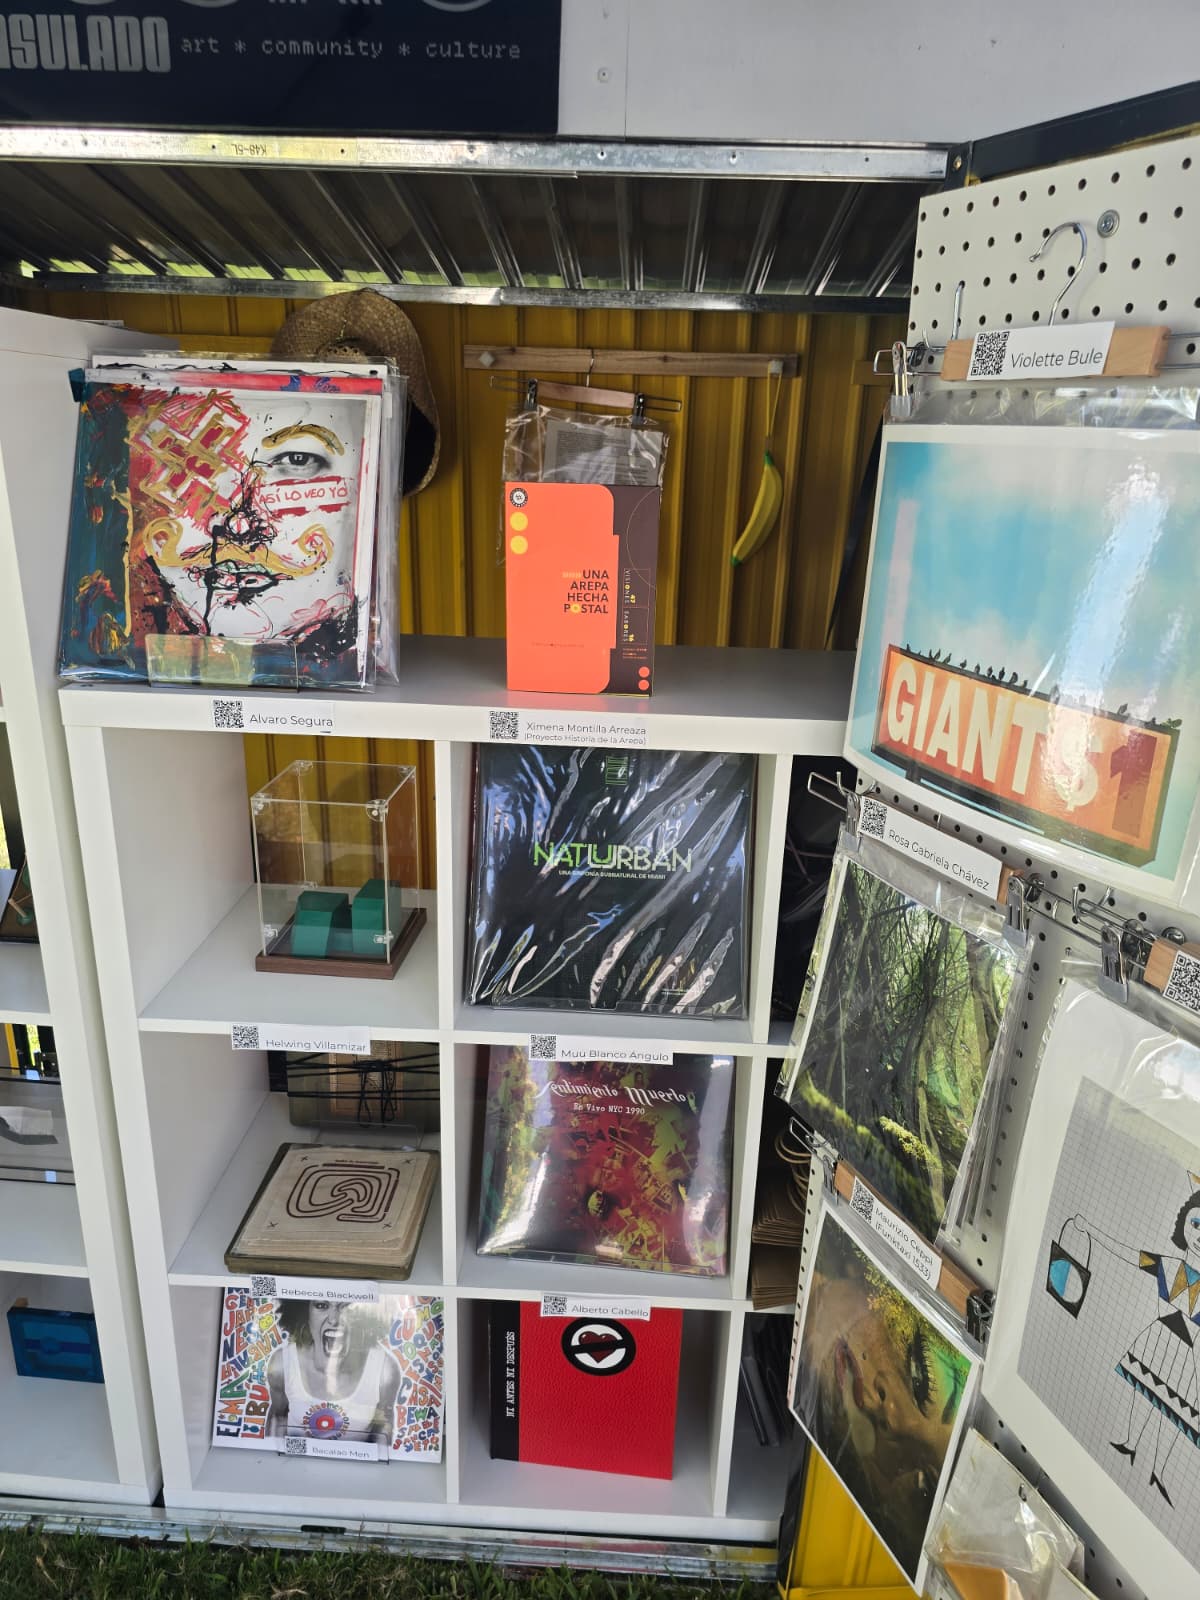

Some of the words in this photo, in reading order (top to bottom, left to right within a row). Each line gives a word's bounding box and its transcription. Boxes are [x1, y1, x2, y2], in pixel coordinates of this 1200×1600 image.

[182, 38, 219, 53] art
[261, 39, 383, 58] community
[426, 42, 521, 59] culture
[1012, 352, 1064, 368] Violette
[1068, 348, 1103, 366] Bule
[285, 491, 302, 501] LO
[305, 488, 325, 498] VEO
[330, 487, 348, 498] YO
[583, 569, 609, 579] UNA
[570, 582, 609, 591] AREPA
[567, 593, 609, 602] HECHA
[564, 604, 609, 614] POSTAL
[250, 714, 287, 725] Alvaro
[290, 715, 333, 727] Segura
[526, 722, 564, 732] Ximena
[567, 724, 606, 734] Montilla
[609, 725, 647, 735] Arreaza
[524, 733, 562, 742] (Proyecto
[564, 735, 594, 743] Historia
[597, 736, 608, 744] de
[889, 829, 910, 849] Rosa
[911, 841, 950, 870] Gabriela
[952, 863, 990, 891] Chávez
[266, 1039, 311, 1050] Helwing
[314, 1041, 366, 1052] Villamizar
[561, 1050, 586, 1058] Muu
[589, 1050, 627, 1058] Blanco
[624, 1086, 687, 1107] Muerto
[586, 1104, 605, 1112] Vivo
[608, 1105, 623, 1113] NYC
[626, 1106, 646, 1115] 1990
[281, 1288, 323, 1298] Rebecca
[326, 1291, 374, 1300] Blackwell
[571, 1304, 608, 1314] Alberto
[611, 1307, 648, 1317] Cabello
[506, 1367, 515, 1378] NI
[506, 1381, 515, 1405] ANTES
[505, 1406, 515, 1418] NI
[349, 1450, 370, 1458] Men
